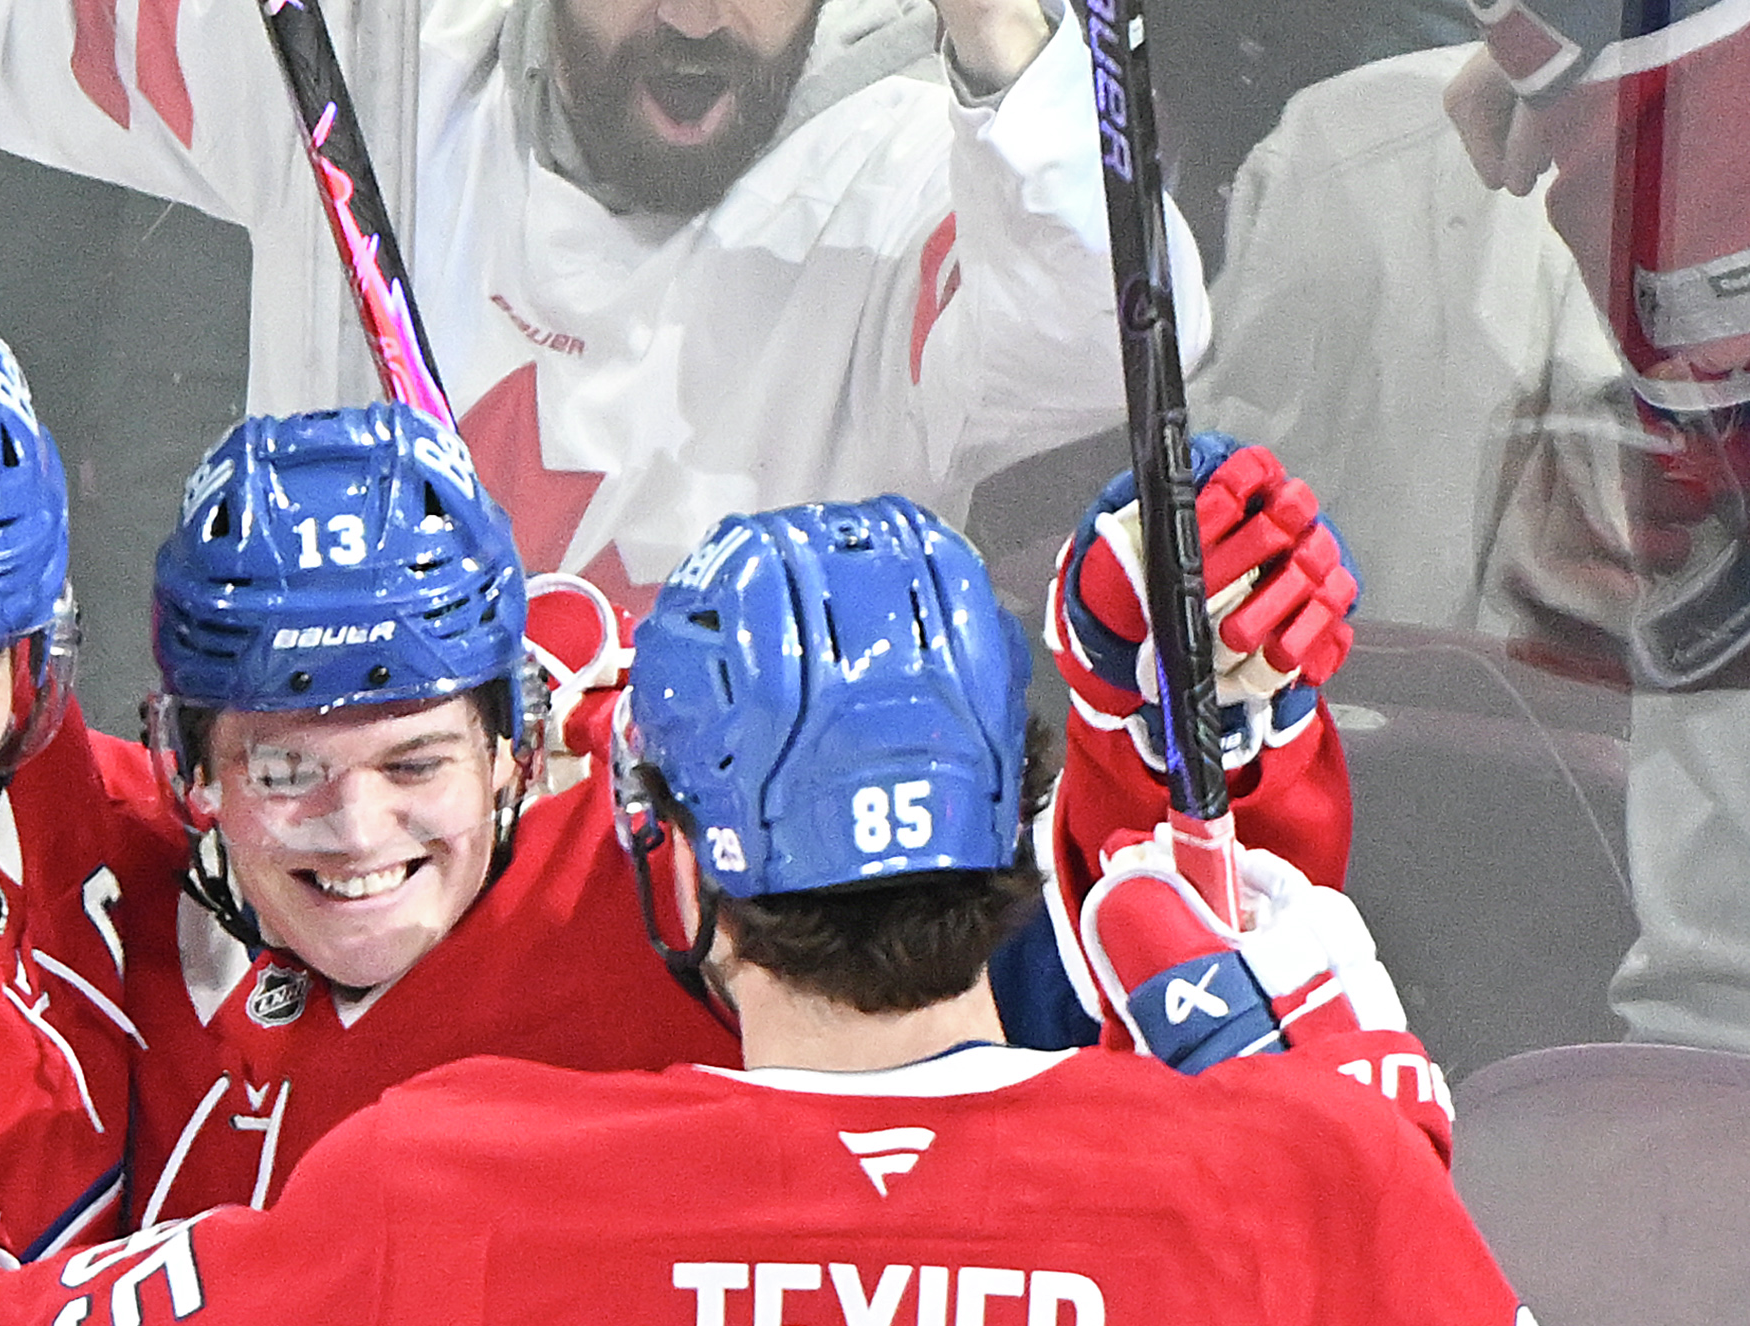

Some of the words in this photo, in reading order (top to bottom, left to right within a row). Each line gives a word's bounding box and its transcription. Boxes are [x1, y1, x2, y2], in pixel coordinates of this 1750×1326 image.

[293, 514, 368, 570] 13
[272, 620, 397, 650] BAUER
[851, 779, 933, 853] 85
